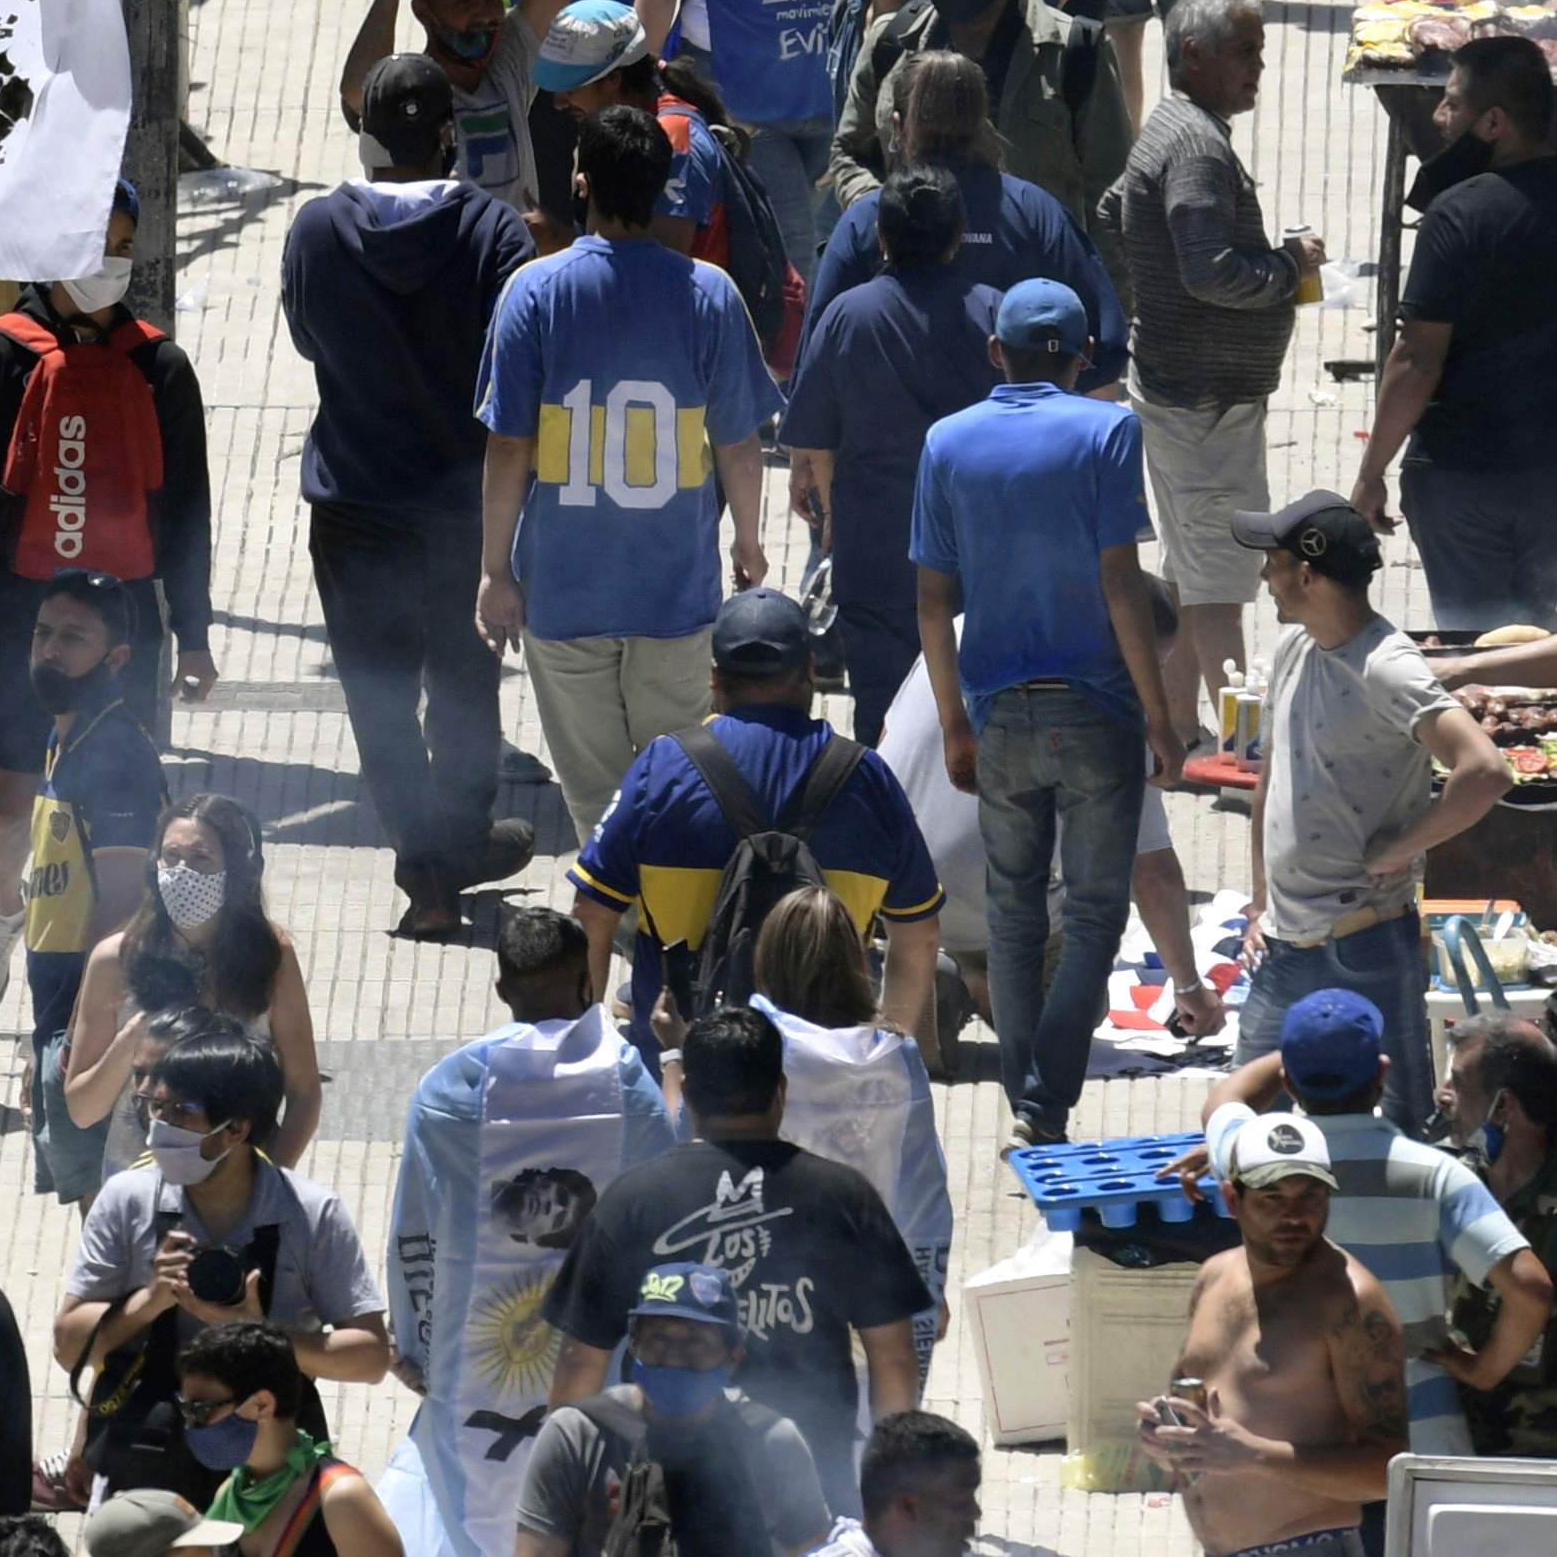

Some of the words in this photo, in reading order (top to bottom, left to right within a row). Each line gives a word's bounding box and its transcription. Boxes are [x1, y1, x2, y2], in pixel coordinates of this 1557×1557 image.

[53, 415, 86, 559] adidas
[558, 377, 677, 510] 10
[738, 1276, 815, 1341] ELITOS
